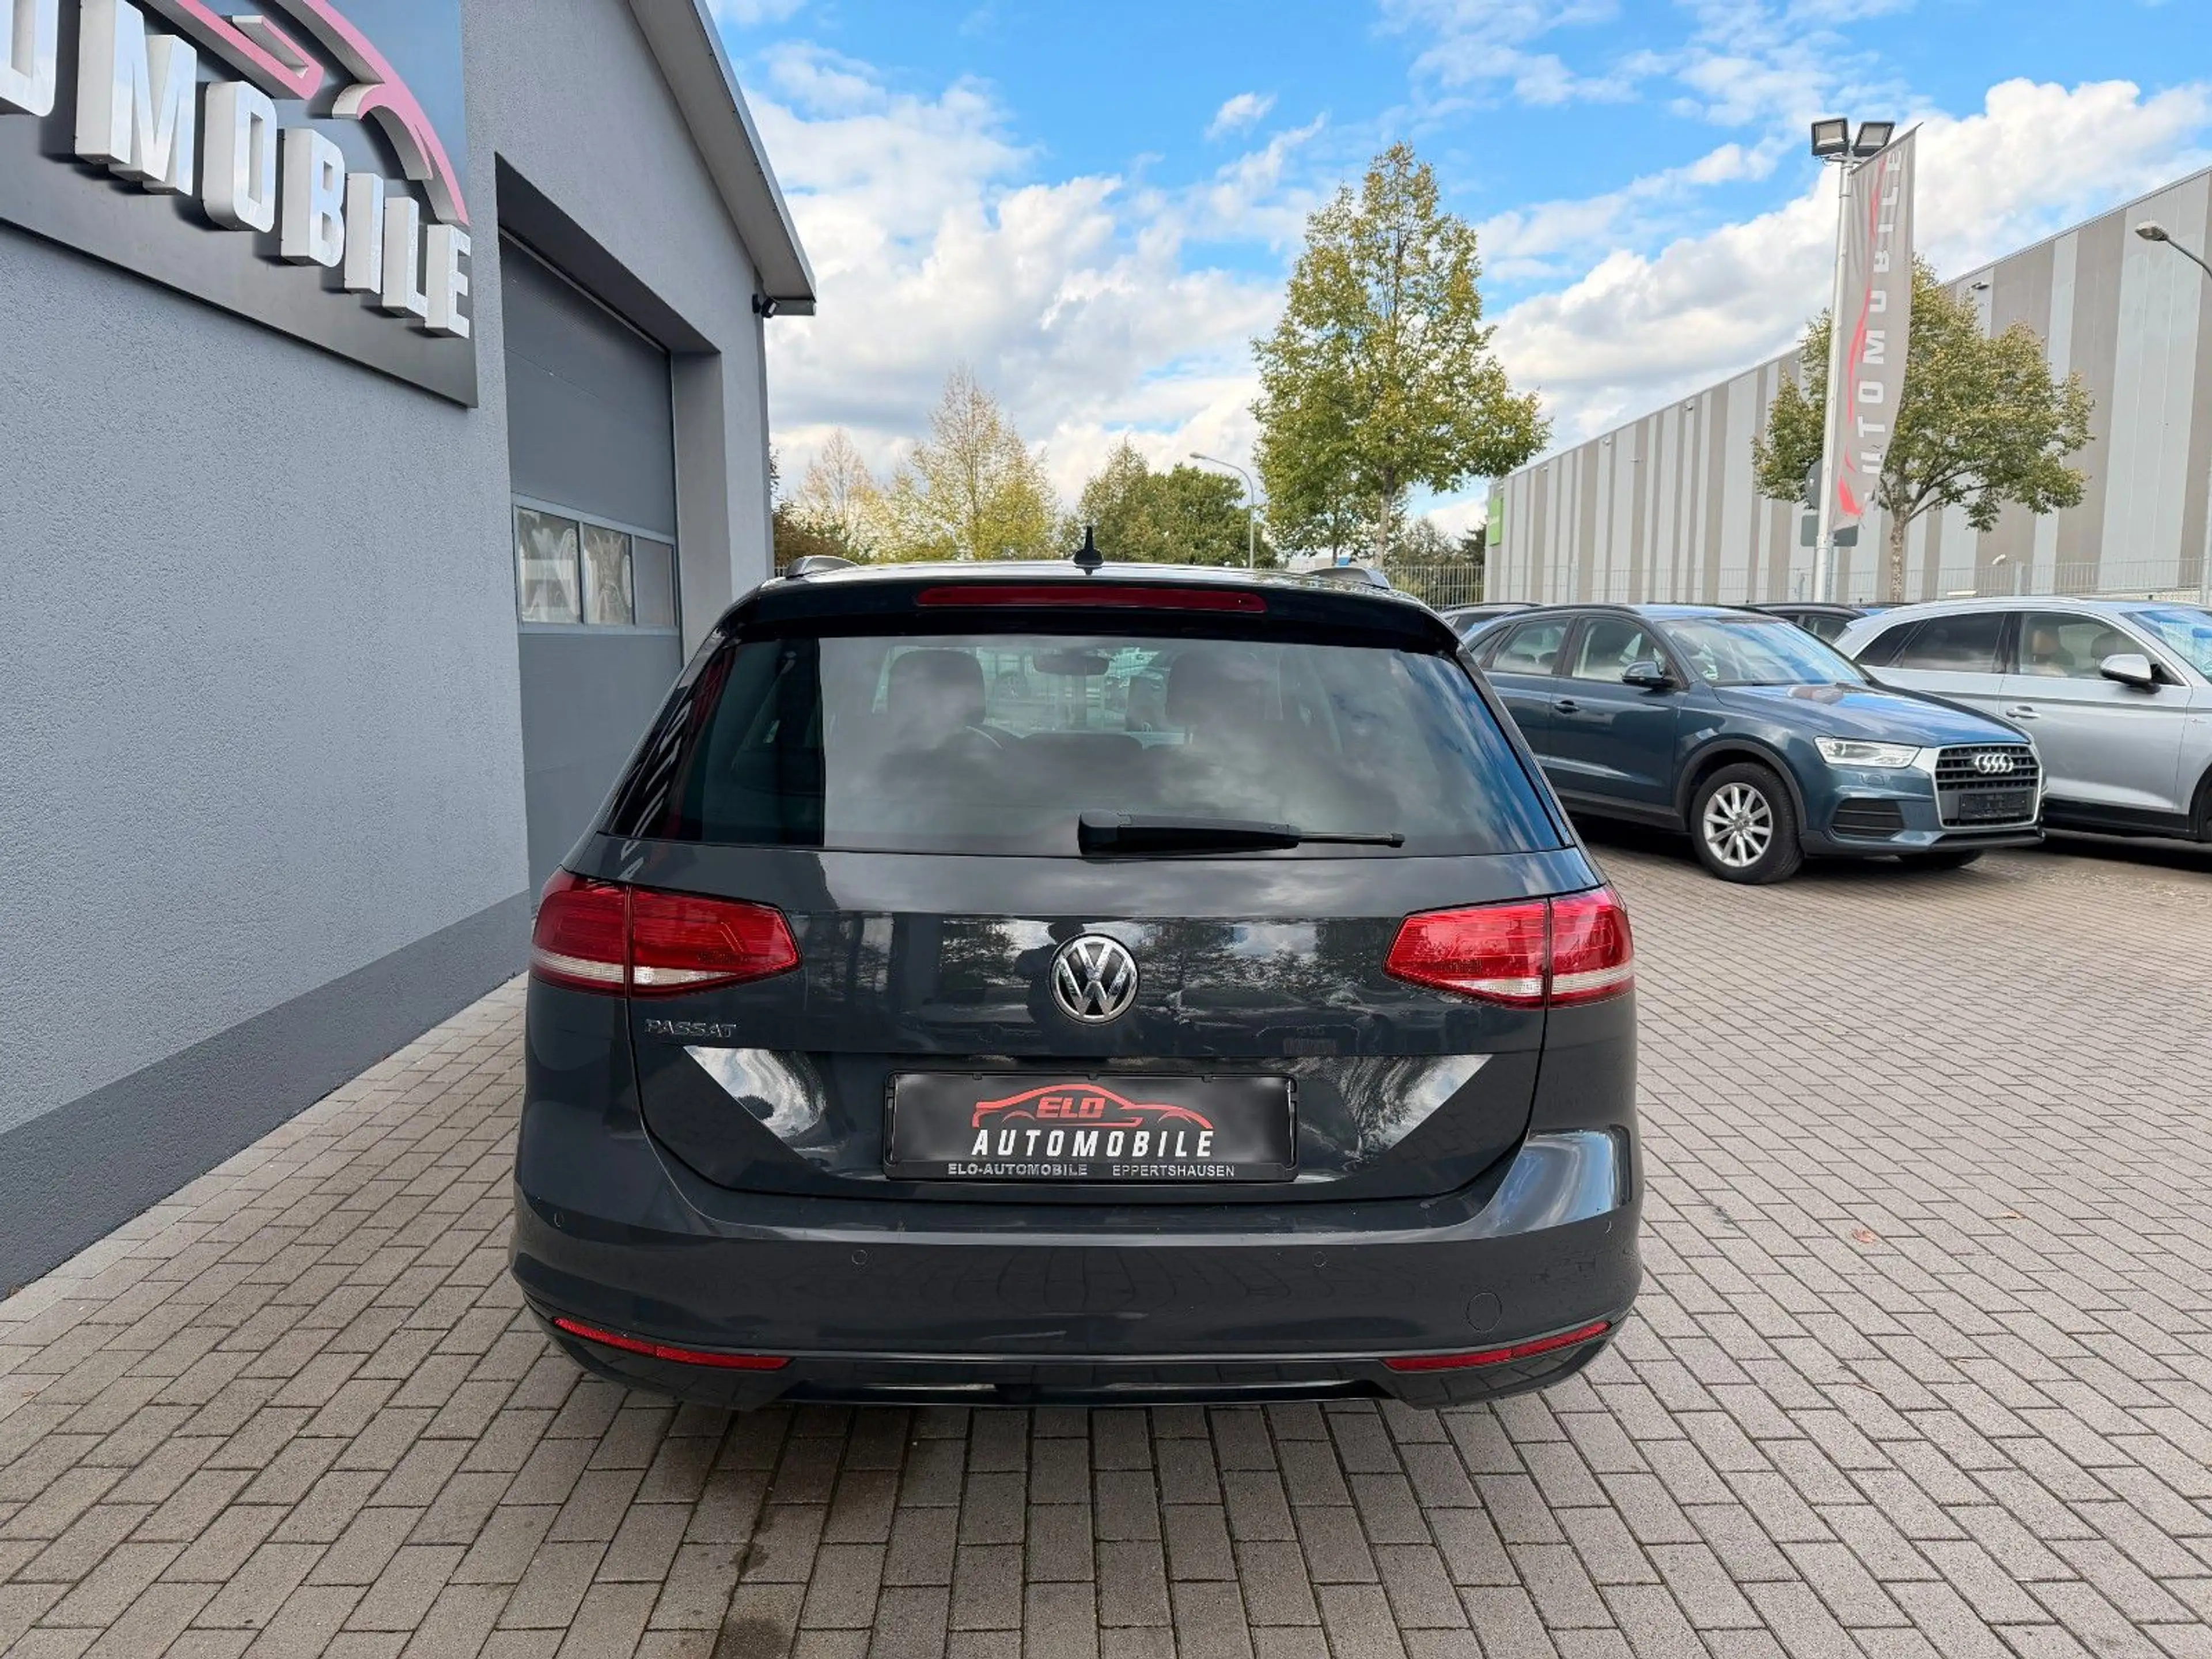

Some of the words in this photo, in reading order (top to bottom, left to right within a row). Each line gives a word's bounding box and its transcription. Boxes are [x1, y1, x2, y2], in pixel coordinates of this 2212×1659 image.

[1856, 149, 1902, 500] UTOMOBILE
[644, 1018, 737, 1037] PASSAT
[1036, 1097, 1107, 1119] ELO
[971, 1128, 1214, 1157] AUTOMOBILE
[948, 1162, 1088, 1176] ELO-AUTOMOBILE
[1112, 1164, 1235, 1177] EPPERTSHAUSEN
